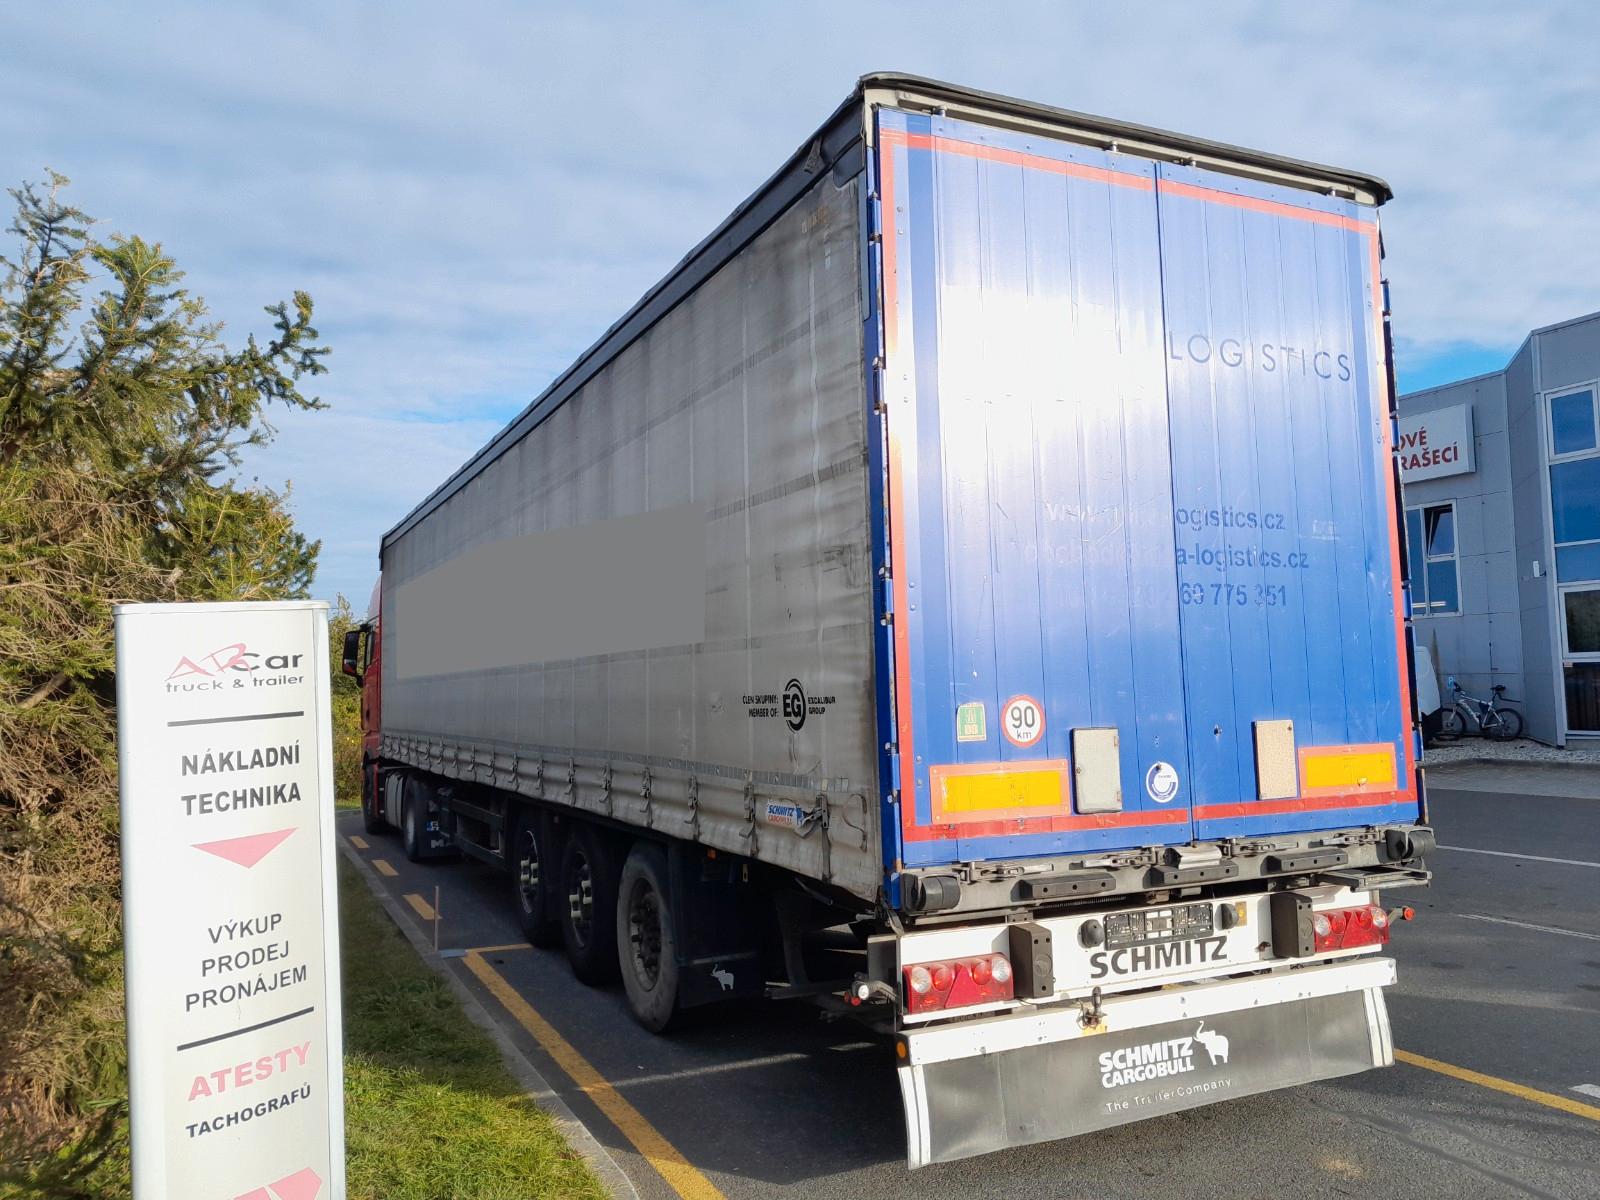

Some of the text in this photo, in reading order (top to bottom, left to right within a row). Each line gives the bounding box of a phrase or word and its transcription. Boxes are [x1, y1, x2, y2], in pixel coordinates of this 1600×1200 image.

[1169, 329, 1351, 382] LOGISTICS
[1210, 583, 1247, 606] 775
[166, 674, 305, 693] truck & trailer
[782, 693, 802, 718] EG
[1011, 706, 1035, 729] 90
[1017, 730, 1032, 739] km
[181, 739, 300, 776] NÁKLADNÍ
[181, 782, 301, 816] TECHNIKA
[208, 913, 282, 944] VÝKUP
[201, 941, 289, 977] PRODEJ
[1090, 936, 1228, 978] SCHMITZ
[185, 965, 308, 1012] PRONÁJEM
[187, 1041, 312, 1102] ATESTY
[1099, 1037, 1193, 1073] SCHMITZ
[1102, 1057, 1195, 1089] CARGOBULL
[185, 1082, 311, 1138] TACHOGRAFŮ
[1106, 1100, 1128, 1112] The
